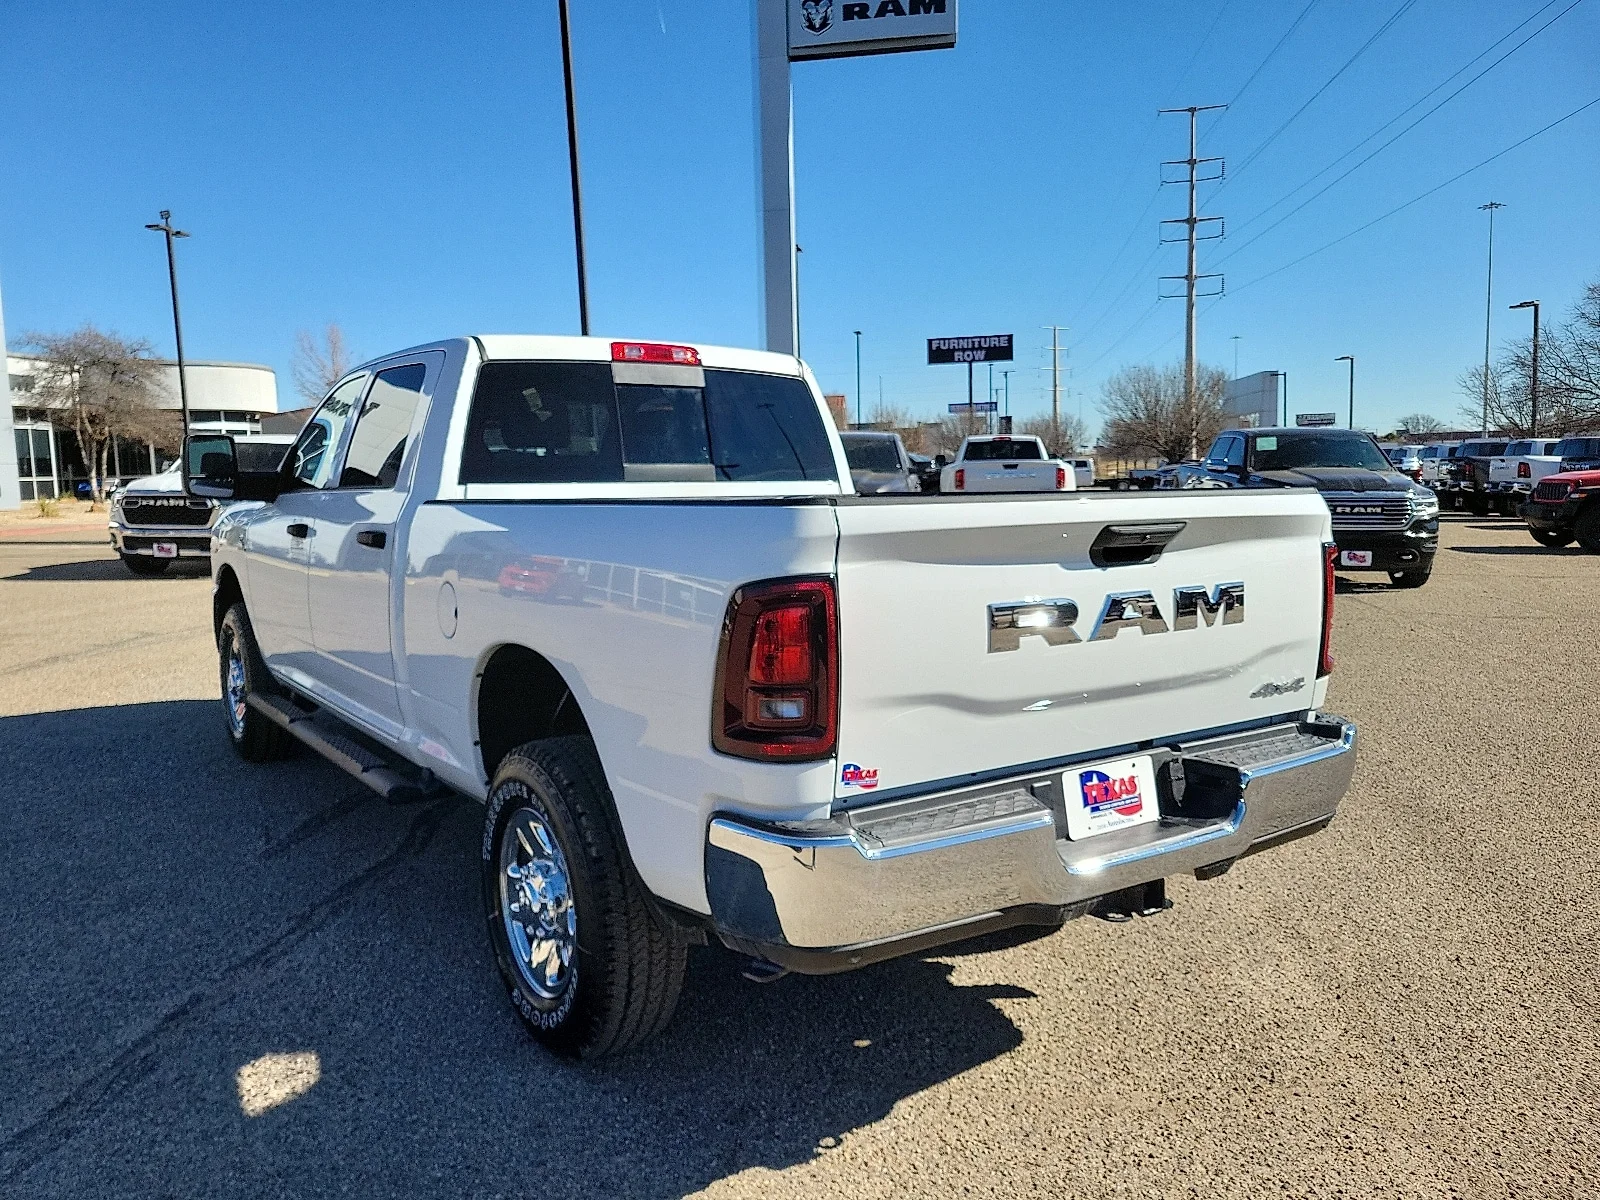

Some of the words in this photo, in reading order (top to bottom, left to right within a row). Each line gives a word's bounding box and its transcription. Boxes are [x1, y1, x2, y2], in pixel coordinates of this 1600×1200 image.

[842, 0, 947, 21] RAM
[931, 336, 1009, 350] FURNITURE
[954, 350, 986, 361] ROW
[986, 581, 1245, 654] RAM
[1083, 775, 1137, 805] TEXAS
